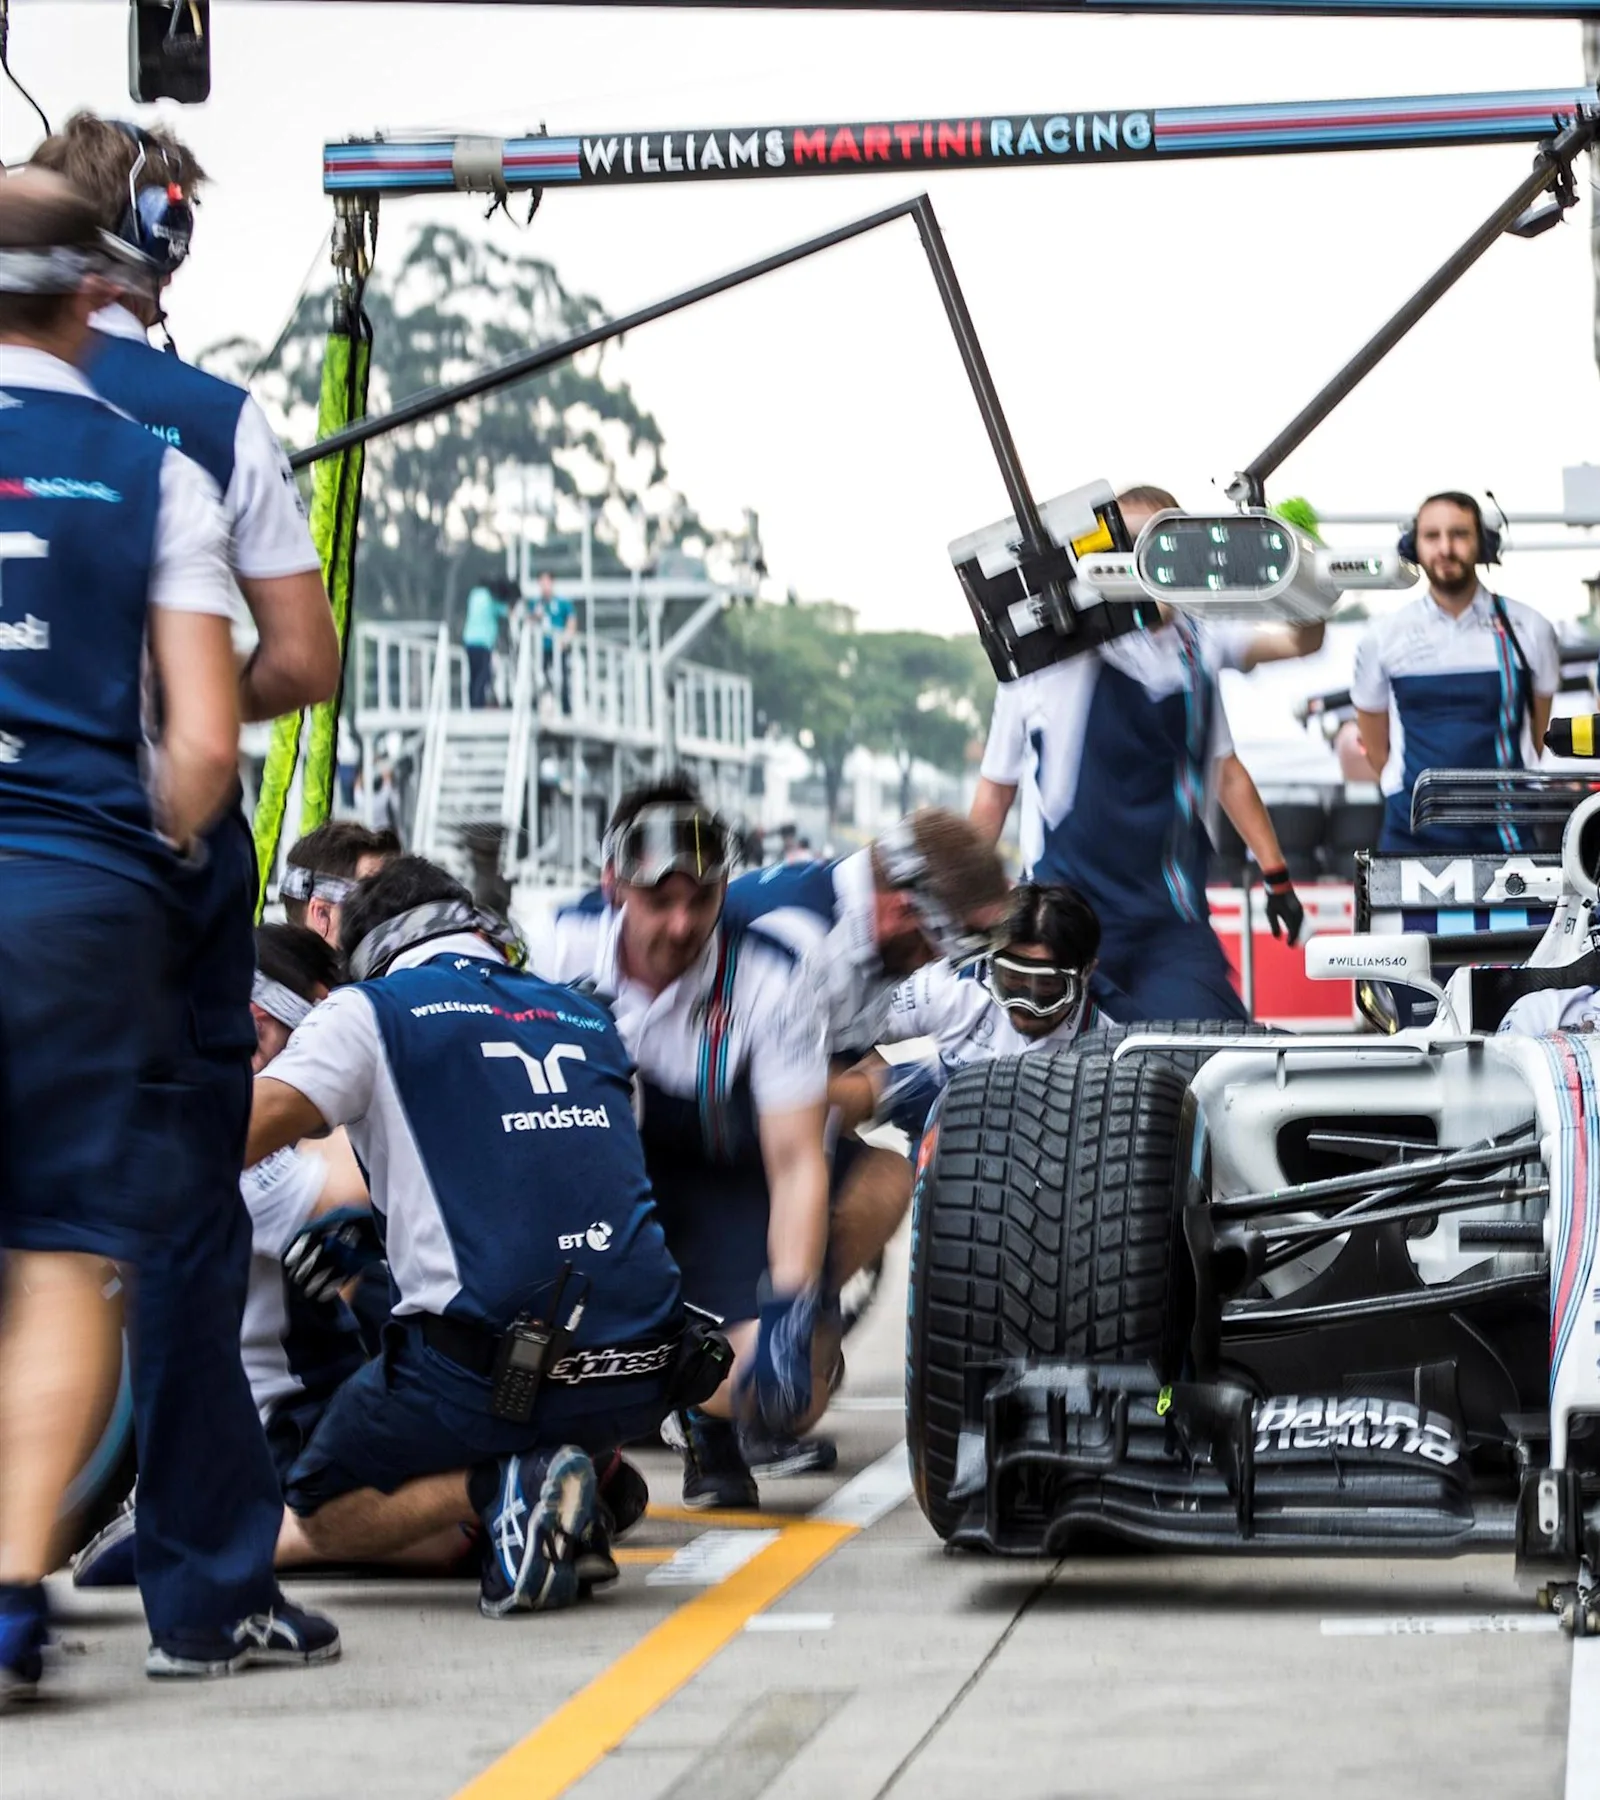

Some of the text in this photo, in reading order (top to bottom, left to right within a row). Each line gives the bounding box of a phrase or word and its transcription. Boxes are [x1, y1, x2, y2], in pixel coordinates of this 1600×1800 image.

[583, 112, 1152, 176] WILLIAMS MARTINI RACING
[1328, 956, 1408, 967] #WILLIAMS40
[410, 1001, 493, 1018] WILLIAMS
[501, 1104, 611, 1133] randstad
[557, 1232, 586, 1250] BT
